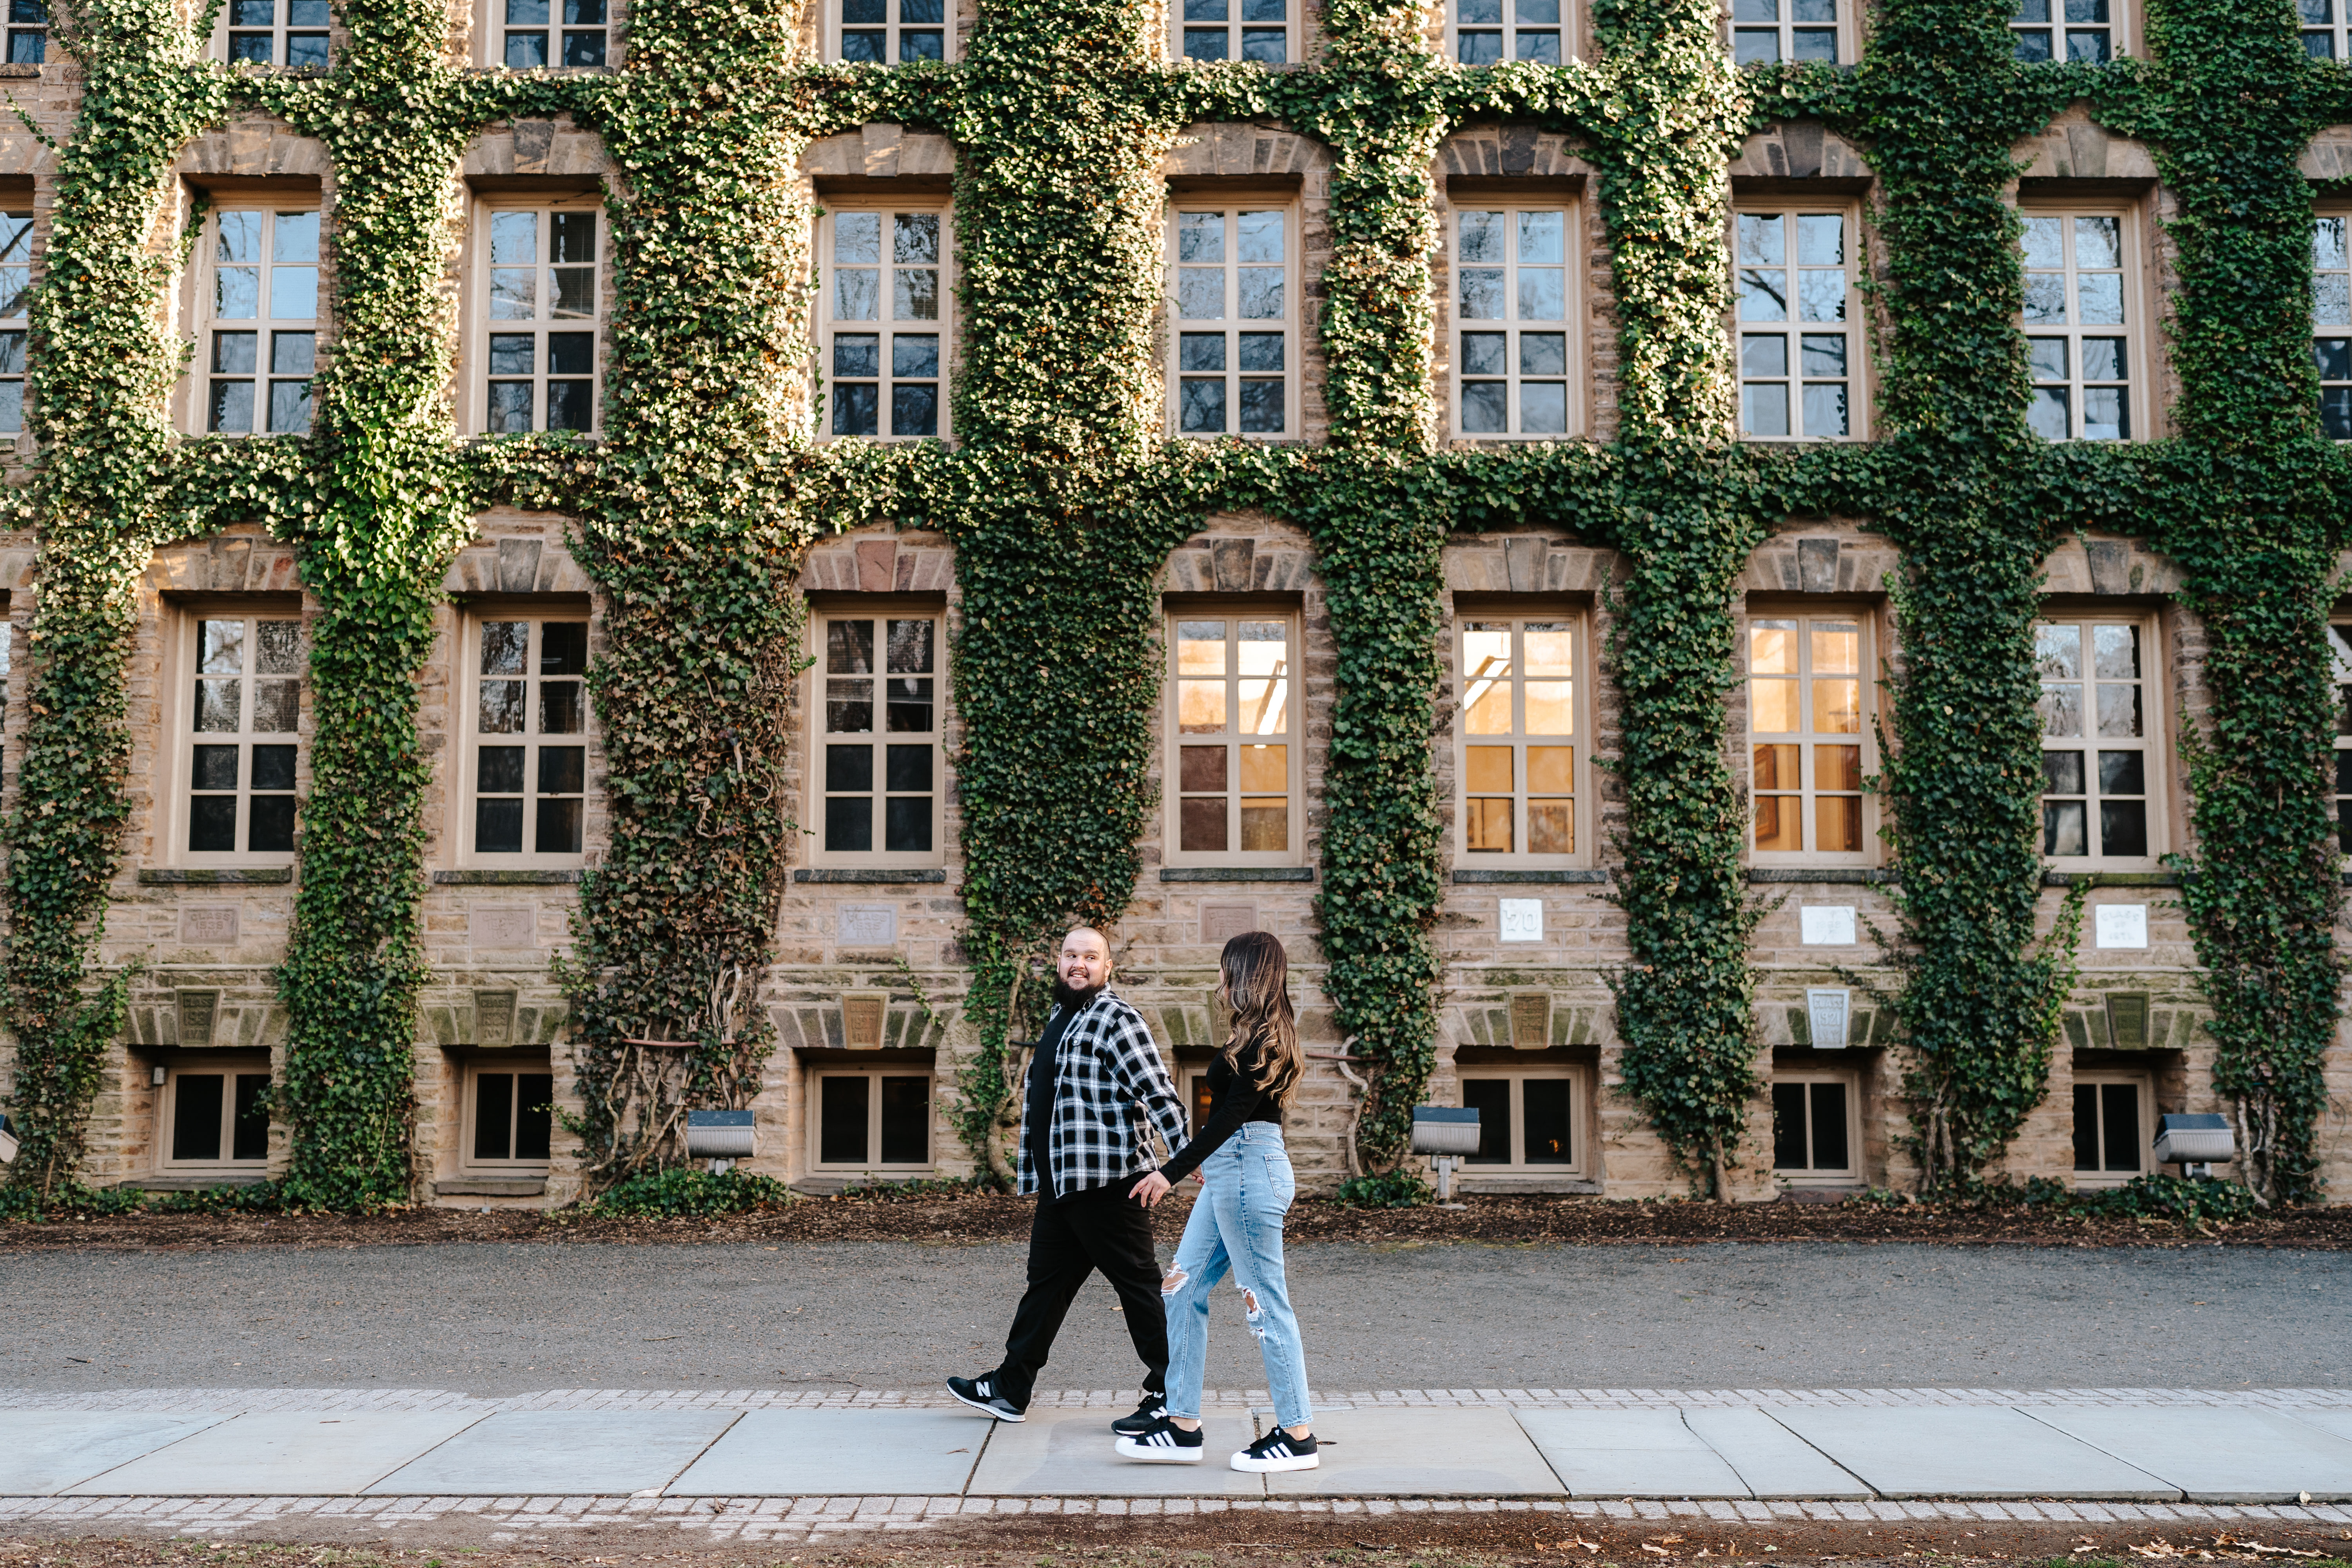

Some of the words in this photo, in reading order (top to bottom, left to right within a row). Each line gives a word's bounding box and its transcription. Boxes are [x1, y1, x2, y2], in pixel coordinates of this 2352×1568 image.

[191, 912, 231, 921] CLASS
[848, 913, 886, 922] CLASS
[1209, 911, 1249, 919] CLASS
[1814, 998, 1843, 1009] CLASS
[1817, 1011, 1841, 1027] 1921
[1816, 1029, 1839, 1040] IVY
[976, 1381, 991, 1397] N
